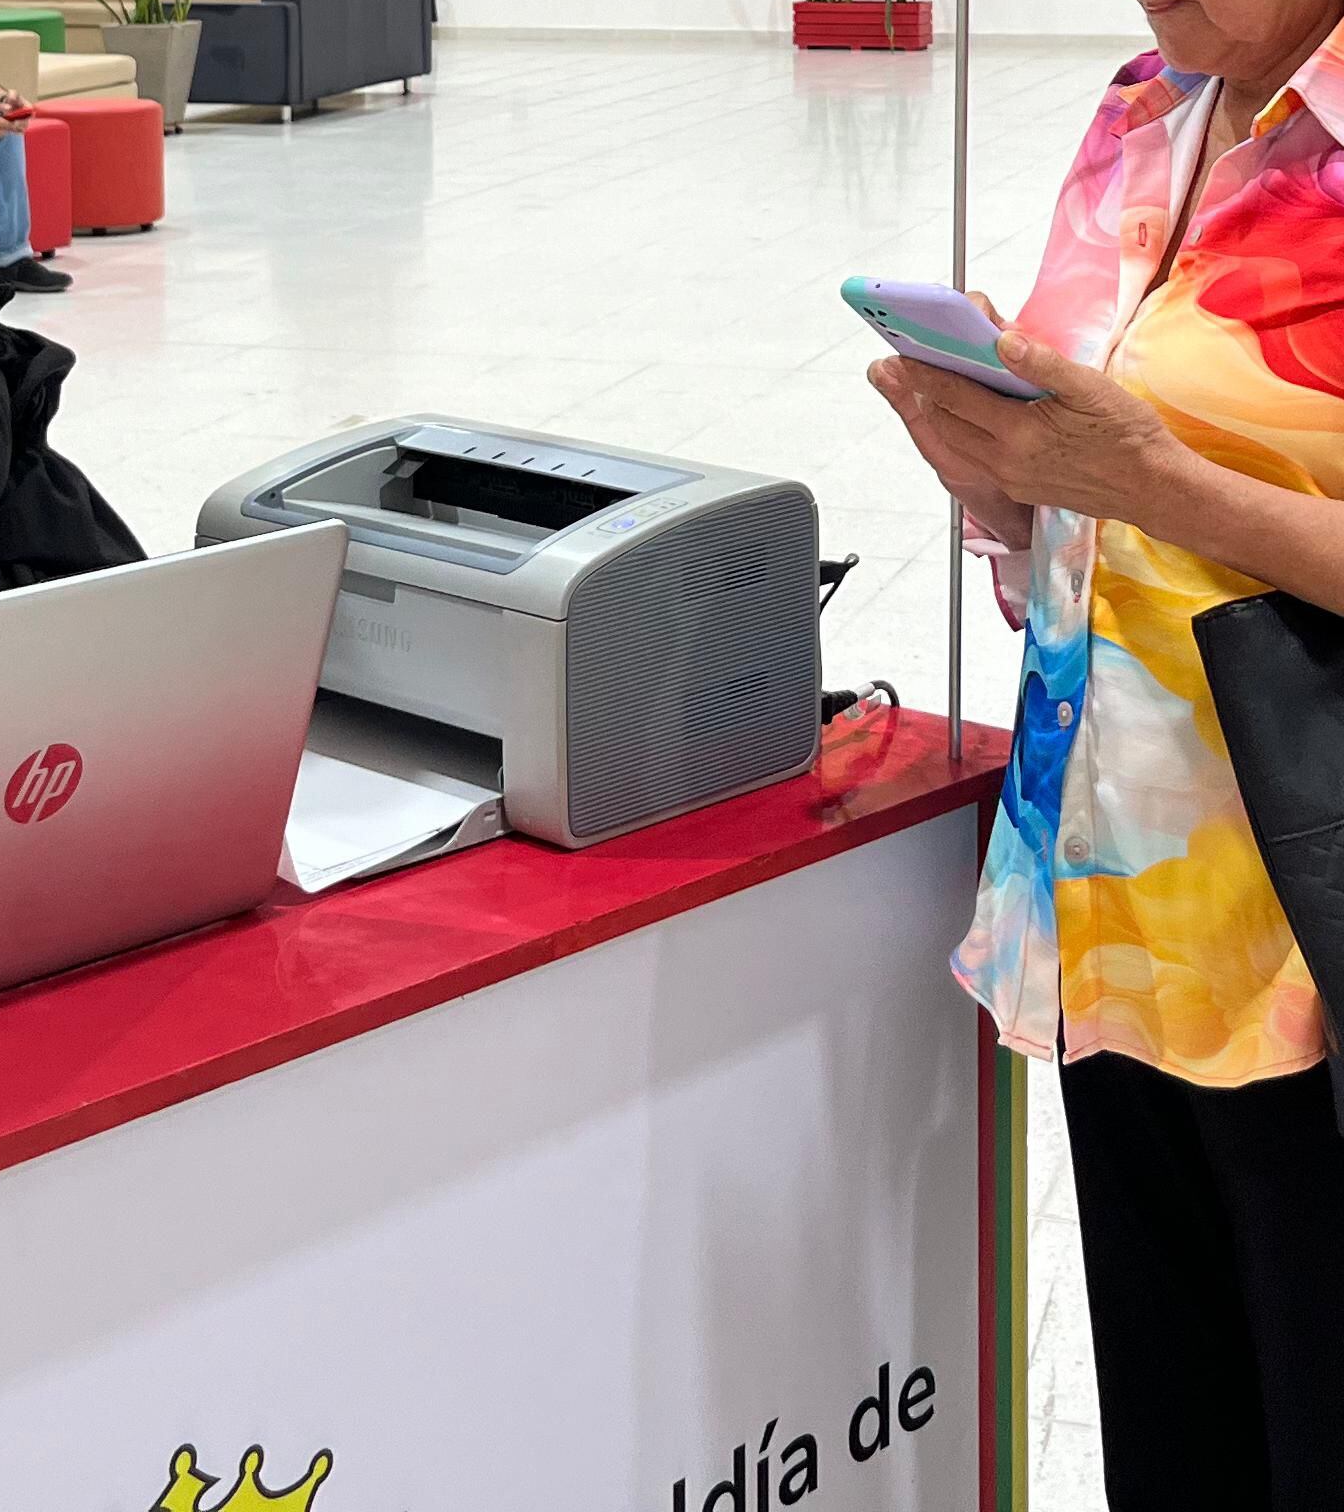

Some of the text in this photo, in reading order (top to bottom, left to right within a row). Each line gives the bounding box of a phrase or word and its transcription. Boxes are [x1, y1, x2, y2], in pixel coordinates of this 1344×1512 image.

[346, 616, 414, 653] SUNG
[8, 744, 80, 824] hp
[848, 1361, 936, 1463] de
